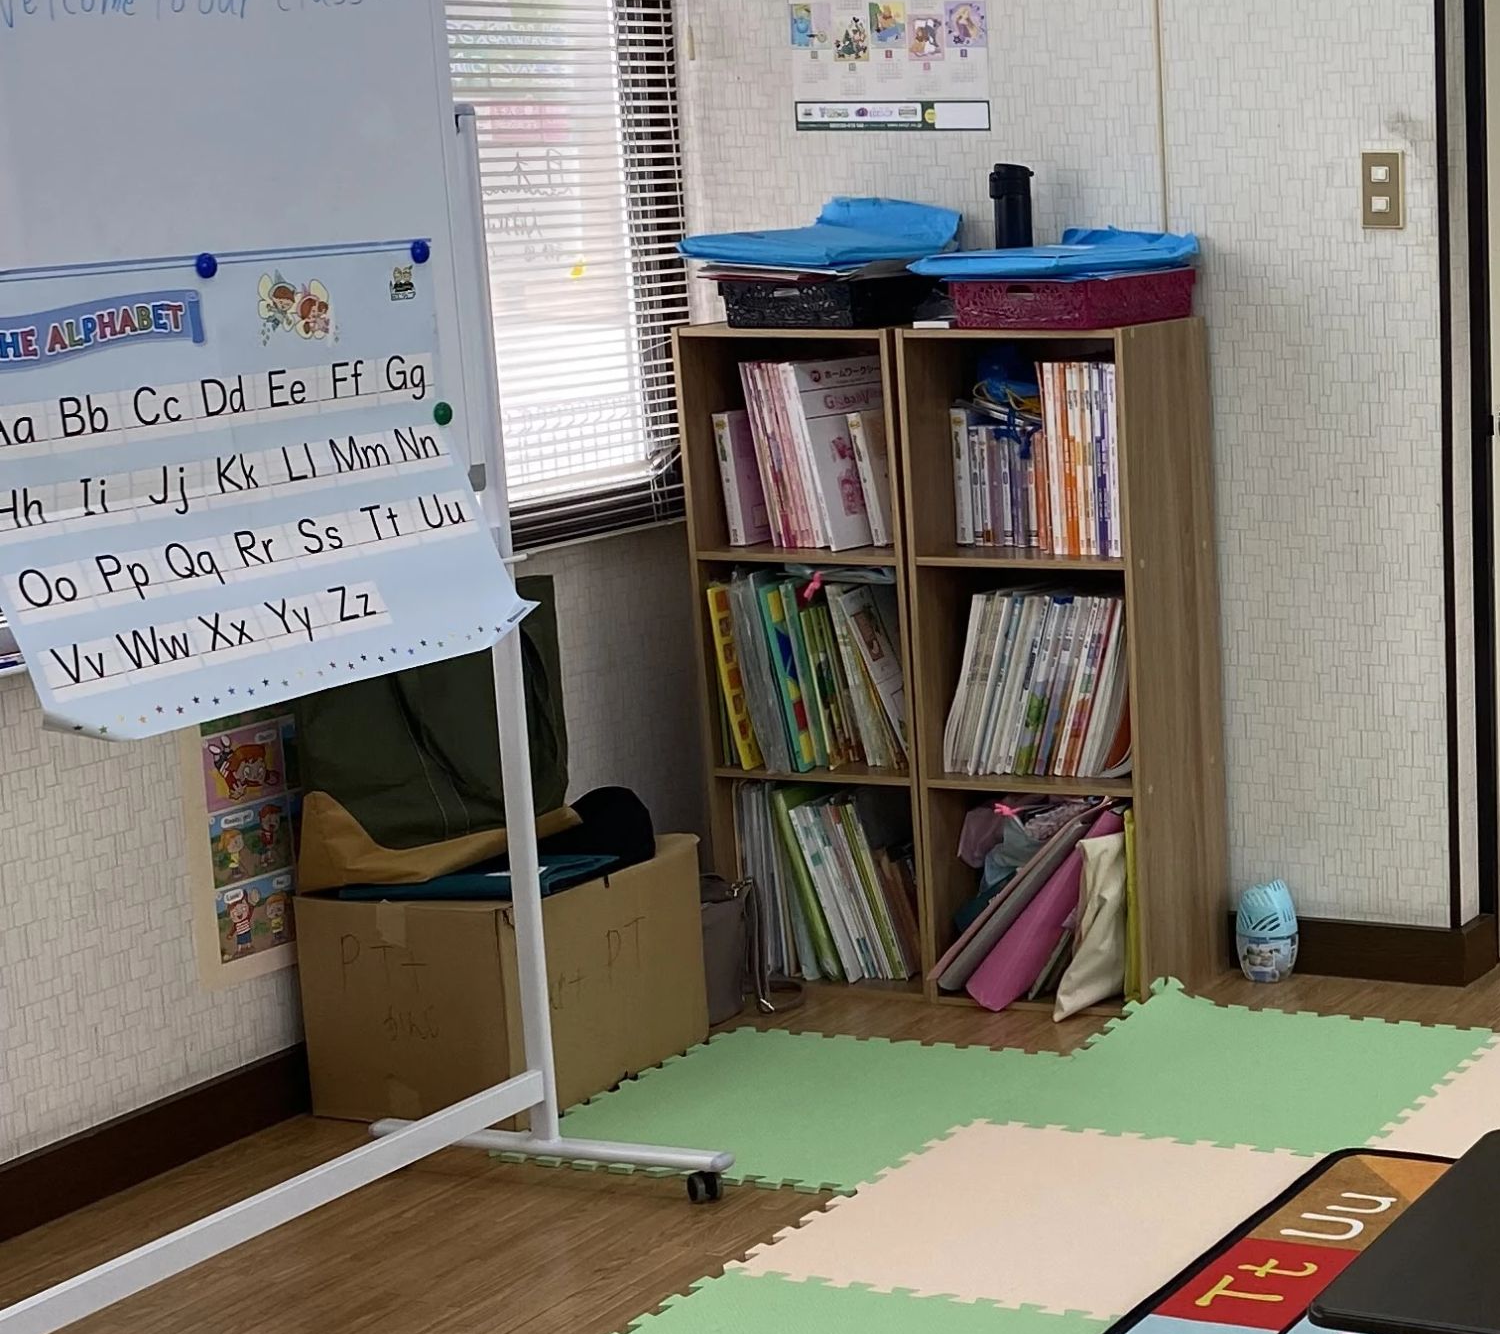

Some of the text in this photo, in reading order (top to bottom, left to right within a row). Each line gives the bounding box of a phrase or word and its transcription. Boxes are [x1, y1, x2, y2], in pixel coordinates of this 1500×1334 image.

[47, 302, 183, 354] ALPHABET
[59, 355, 426, 437] Bb Cc Dd Ee Ff Gg
[80, 427, 441, 516] Ii Jj Kk Ll Mm Nn
[18, 495, 467, 609] Oo Pp Qq Rr Ss Tt Uu
[50, 586, 377, 686] Vv Ww Xx Yy Zz
[1280, 1192, 1397, 1240] Uu
[1194, 1259, 1318, 1306] Tt
